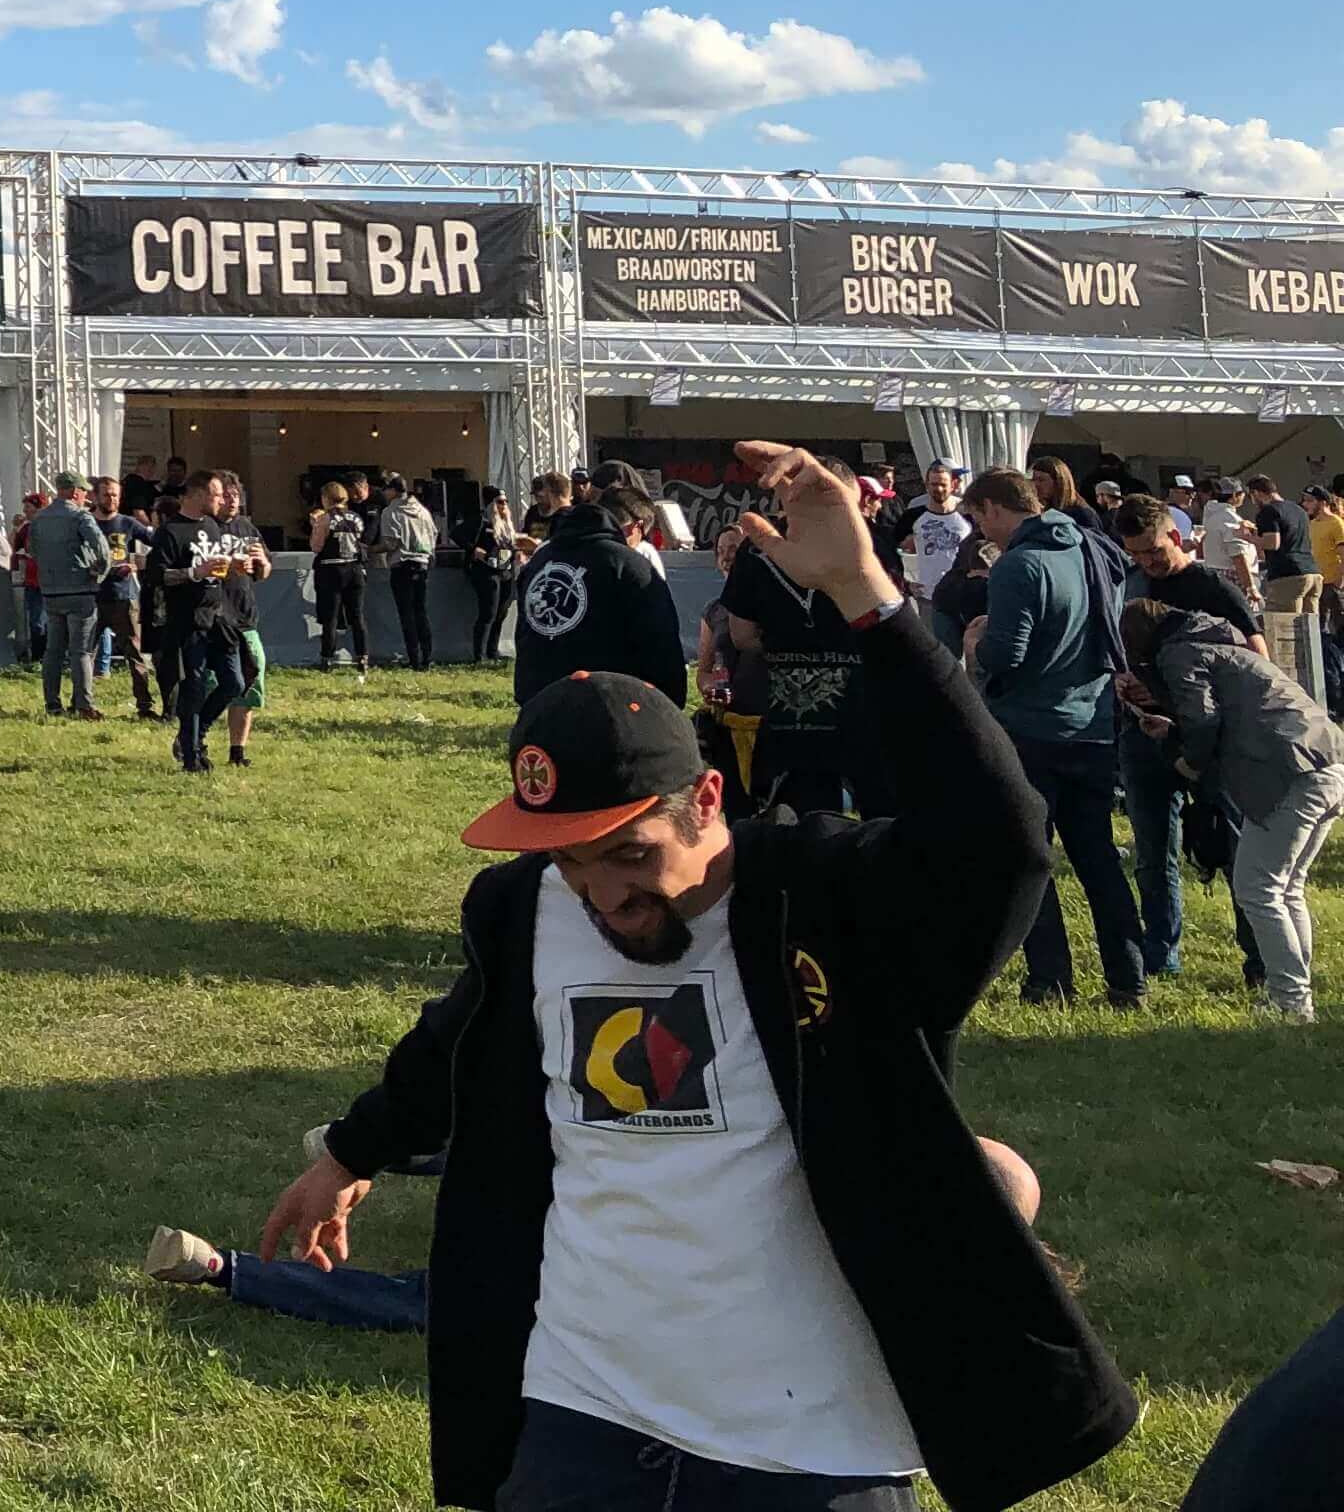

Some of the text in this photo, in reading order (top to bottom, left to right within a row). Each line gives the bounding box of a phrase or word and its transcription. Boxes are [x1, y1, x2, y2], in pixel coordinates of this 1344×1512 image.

[132, 216, 482, 296] COFFEE BAR
[587, 226, 783, 253] MEXICANO/FRIKANDEL
[851, 234, 937, 274] BICKY
[617, 258, 756, 282] BRAADWORSTEN
[1062, 261, 1141, 307] WOK
[636, 288, 742, 313] HAMBURGER
[842, 277, 954, 316] BURGER
[1248, 269, 1344, 314] KEBAB
